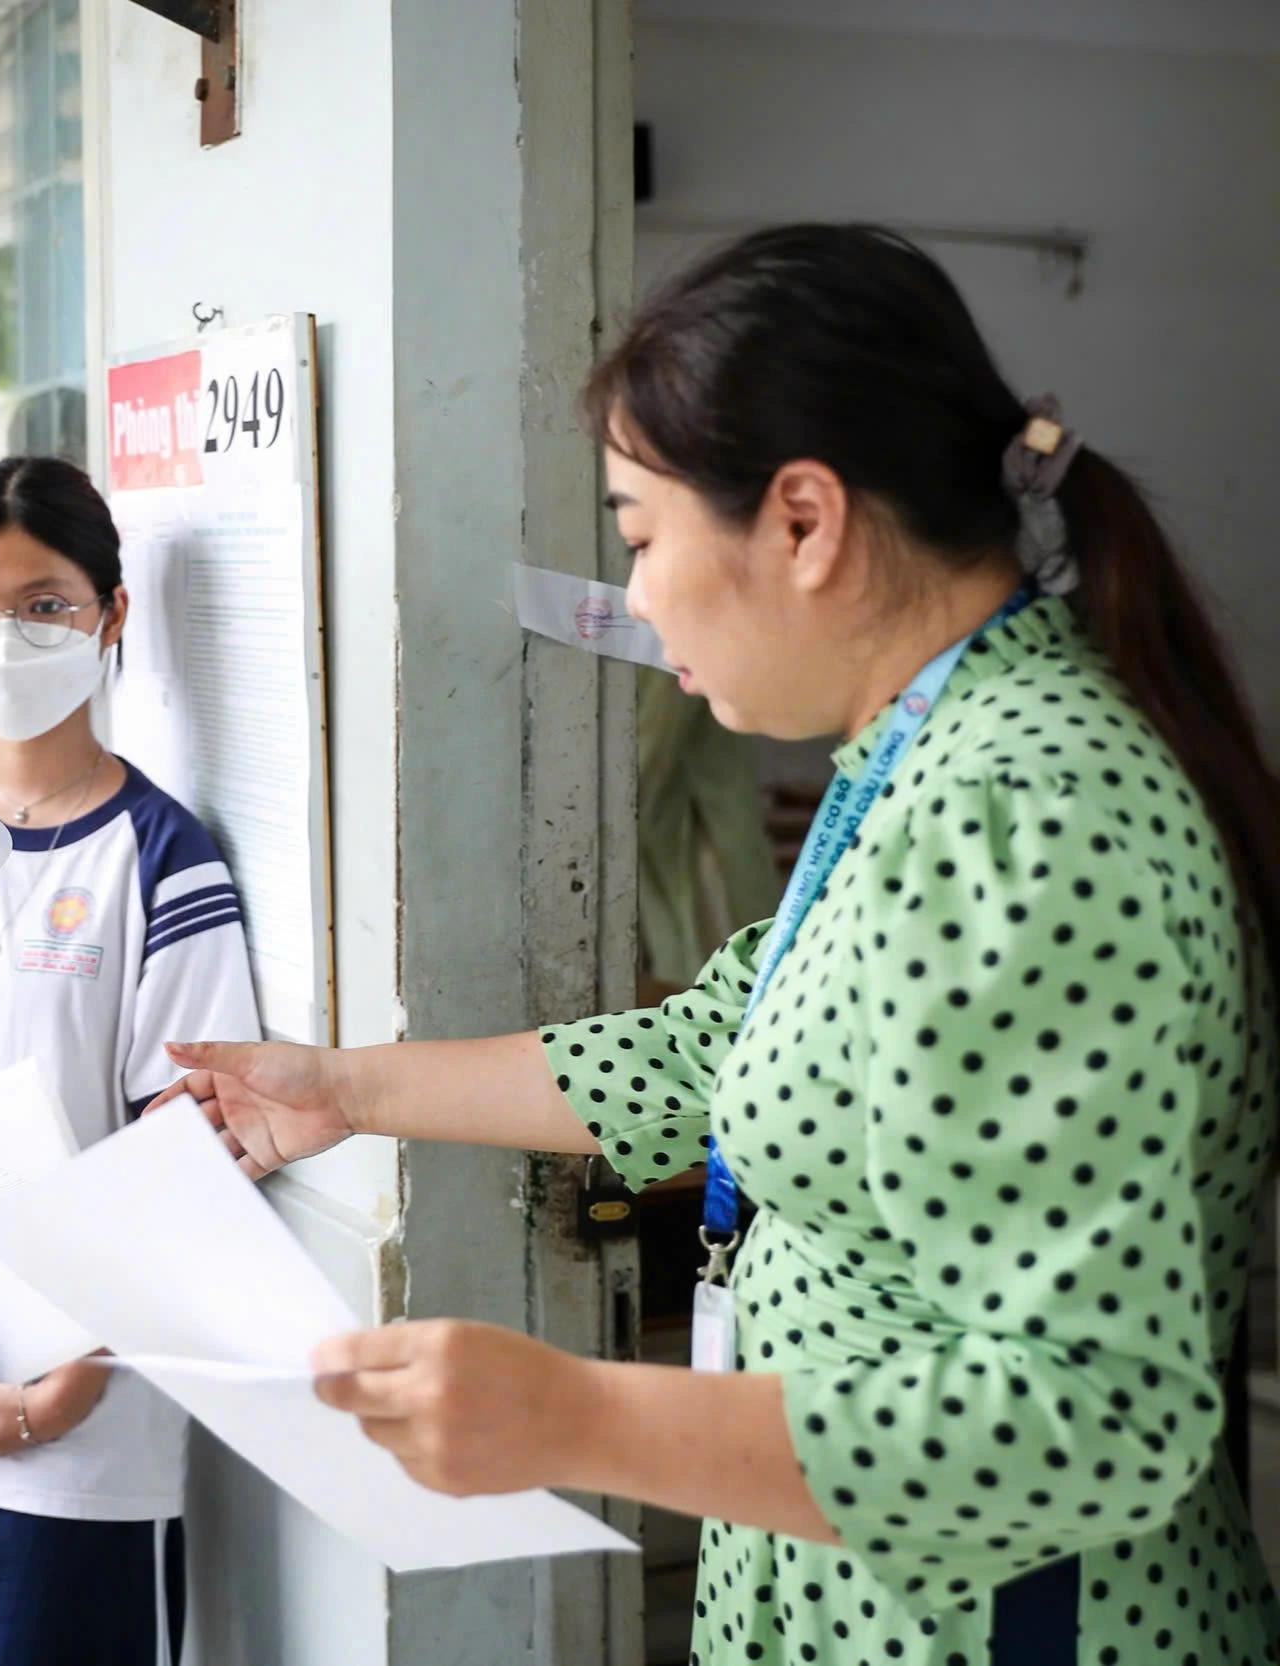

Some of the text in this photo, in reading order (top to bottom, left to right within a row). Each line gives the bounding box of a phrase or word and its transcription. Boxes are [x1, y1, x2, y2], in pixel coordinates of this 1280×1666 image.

[112, 396, 172, 459] Phòng
[204, 368, 284, 453] 2949
[875, 731, 905, 776] LONG
